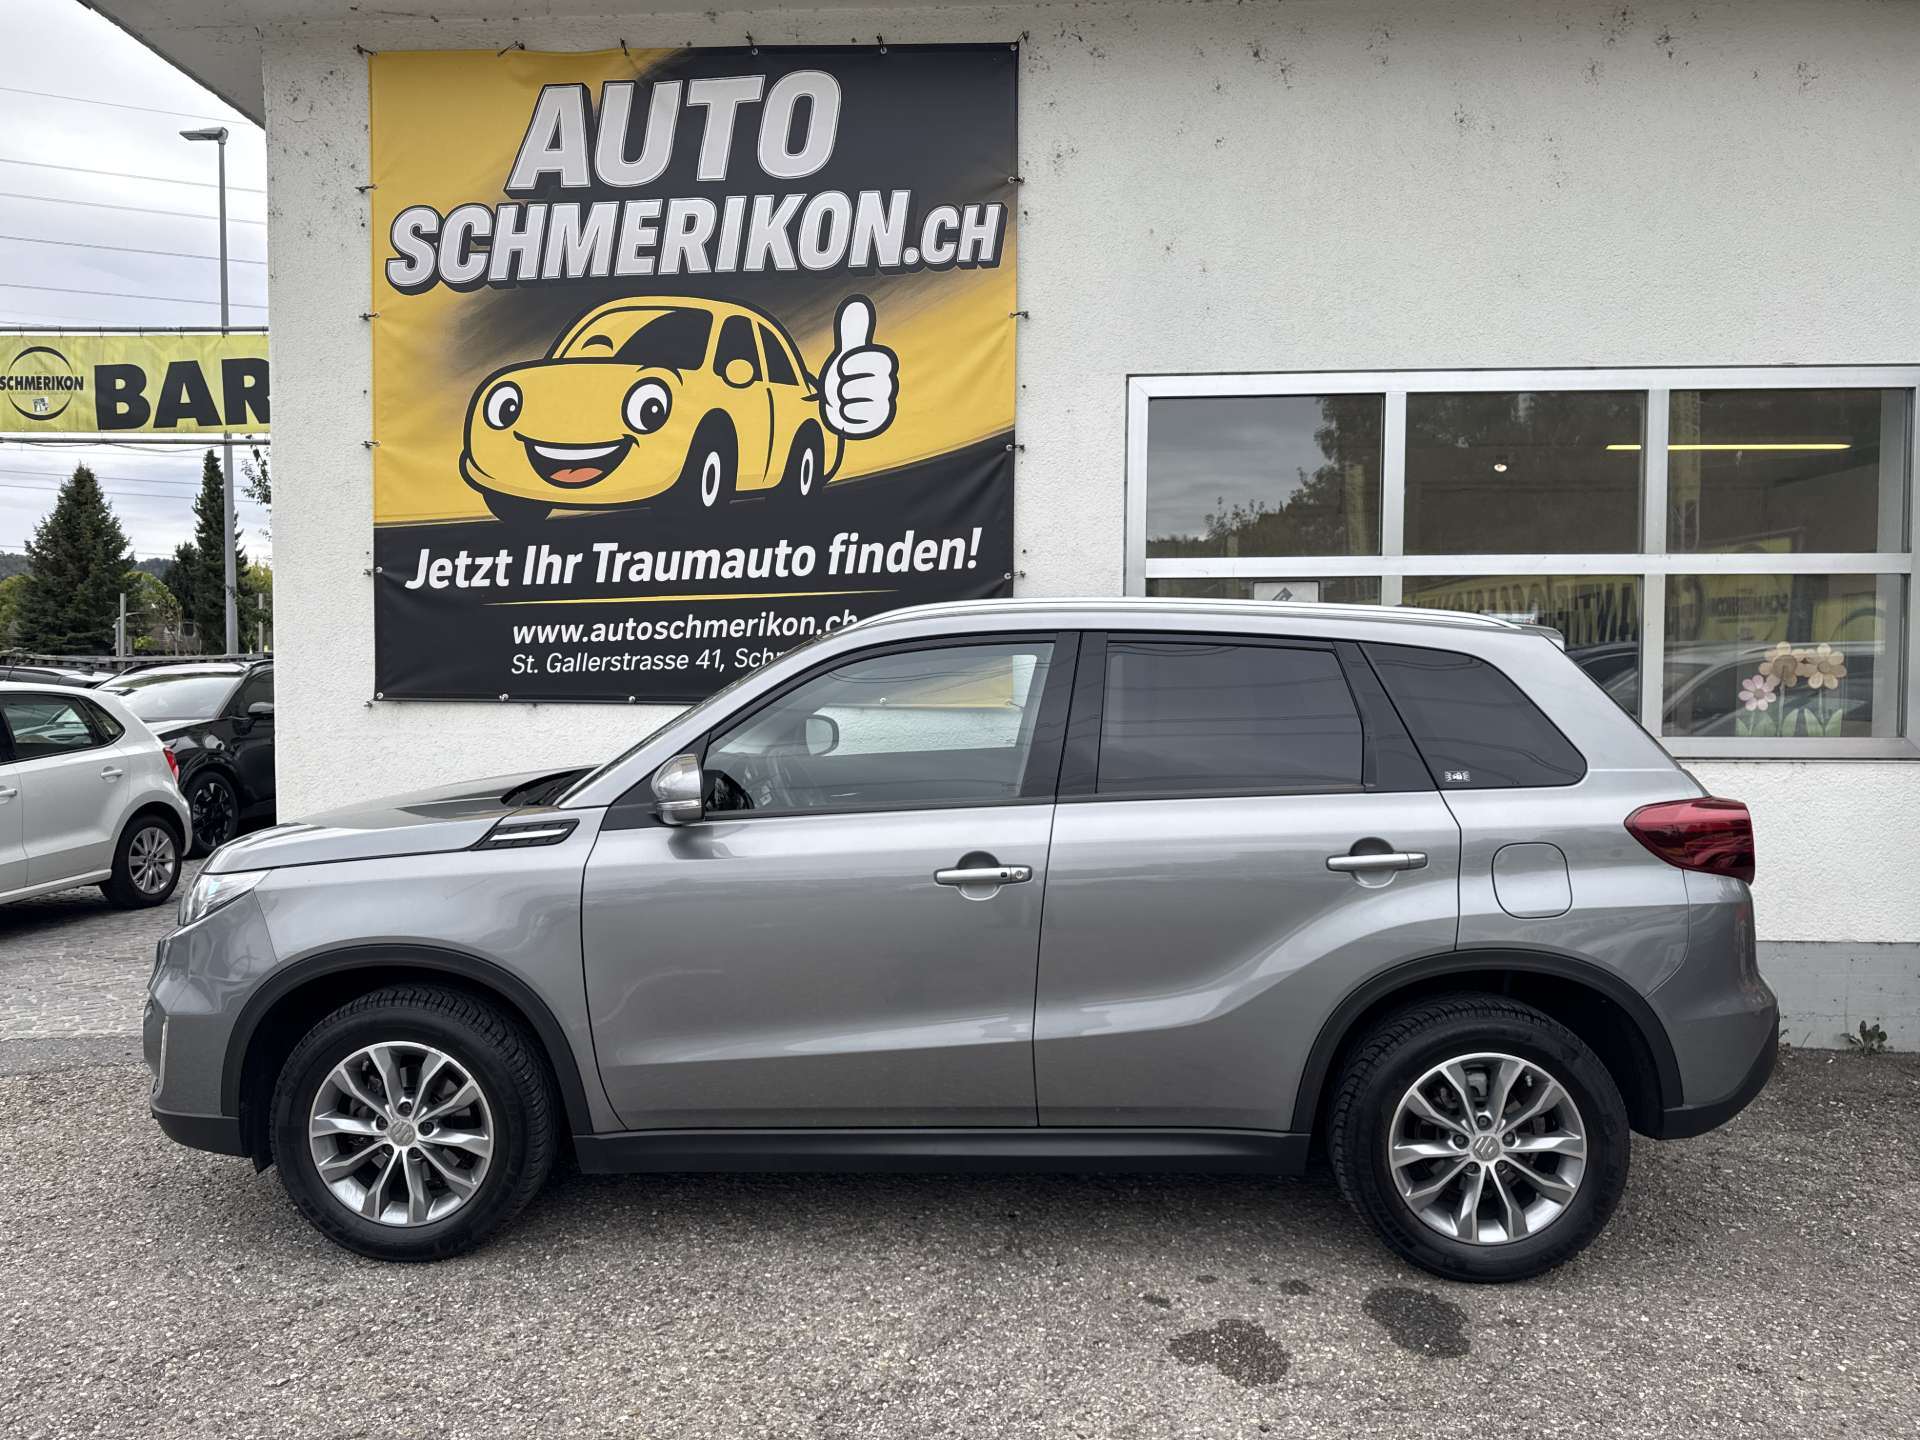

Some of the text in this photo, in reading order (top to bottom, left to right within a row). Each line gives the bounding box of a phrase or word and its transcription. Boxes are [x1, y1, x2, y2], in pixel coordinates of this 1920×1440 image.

[506, 69, 843, 191] AUTO
[386, 188, 1003, 287] SCHMERIKON.CH
[0, 375, 84, 391] SCHMERIKON
[94, 357, 270, 430] BAR
[404, 526, 983, 590] Jetzt Ihr Traumauto finden!
[512, 608, 858, 645] www.autoschmerikon.ch
[510, 653, 539, 675] St.
[546, 651, 689, 674] Gallerstrasse
[695, 648, 725, 673] 41,
